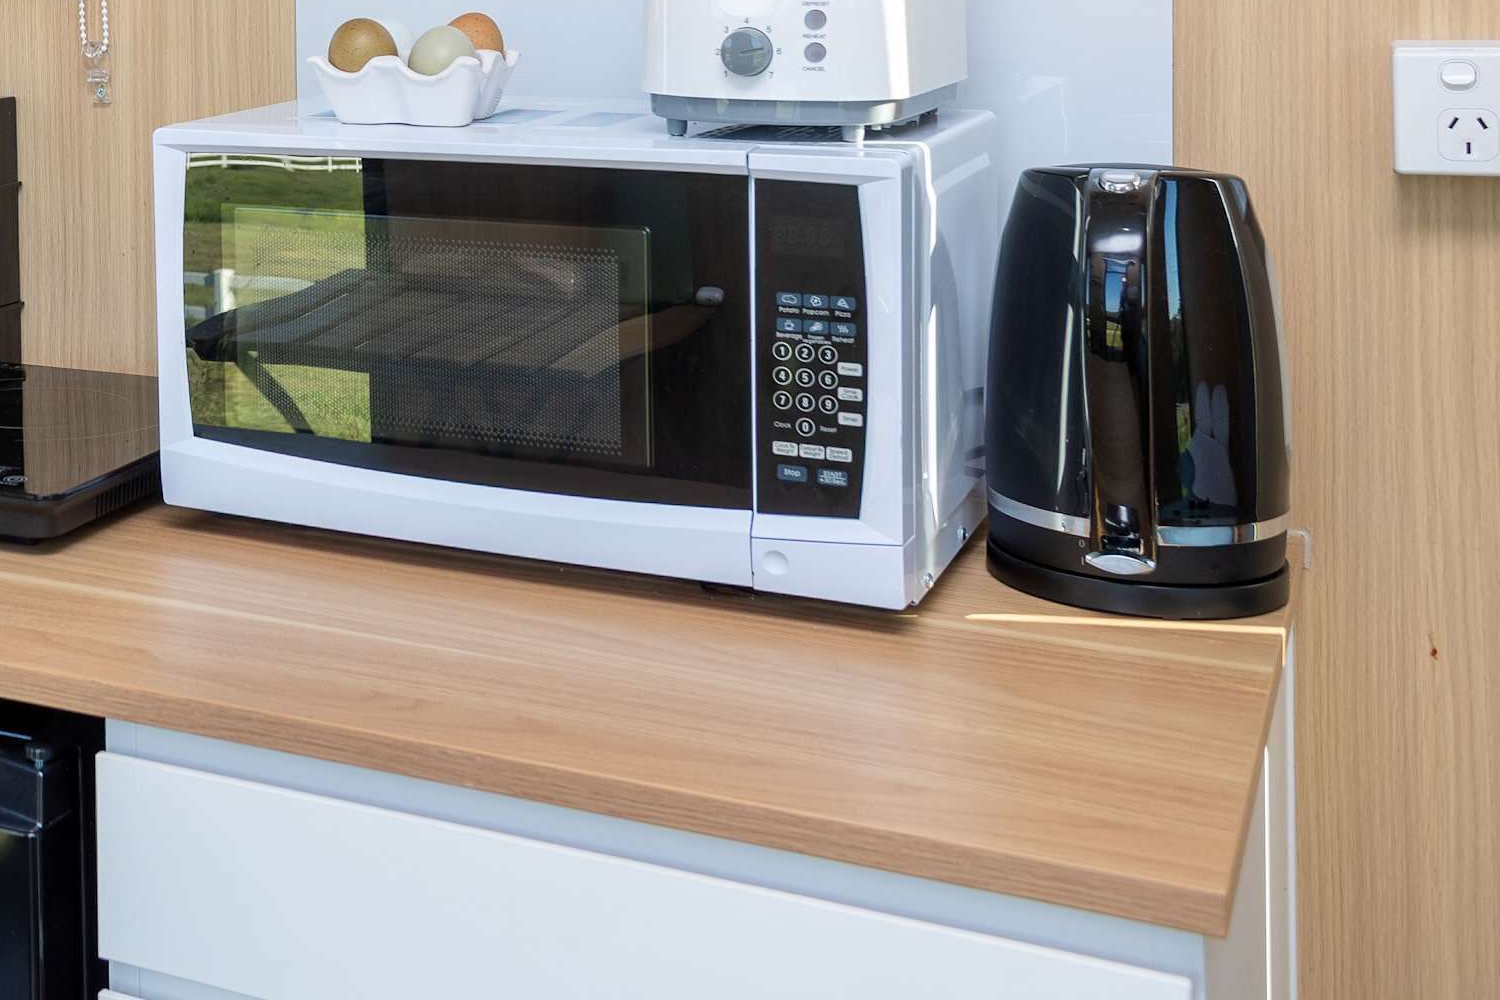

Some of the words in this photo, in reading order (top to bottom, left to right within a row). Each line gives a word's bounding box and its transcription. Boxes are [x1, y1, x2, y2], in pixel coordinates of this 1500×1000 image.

[778, 306, 800, 314] Potato
[802, 307, 830, 317] Popcorn
[834, 310, 852, 318] Pizza
[831, 335, 855, 344] Reheat
[780, 346, 786, 357] 1
[801, 348, 809, 359] 2
[824, 350, 832, 360] 3
[778, 370, 786, 381] 4
[801, 372, 809, 383] 5
[824, 374, 832, 385] 6
[779, 395, 787, 406] 7
[802, 397, 809, 408] 8
[824, 399, 832, 410] 9
[773, 421, 792, 429] Clock
[802, 421, 809, 433] 0
[783, 467, 801, 478] Stop
